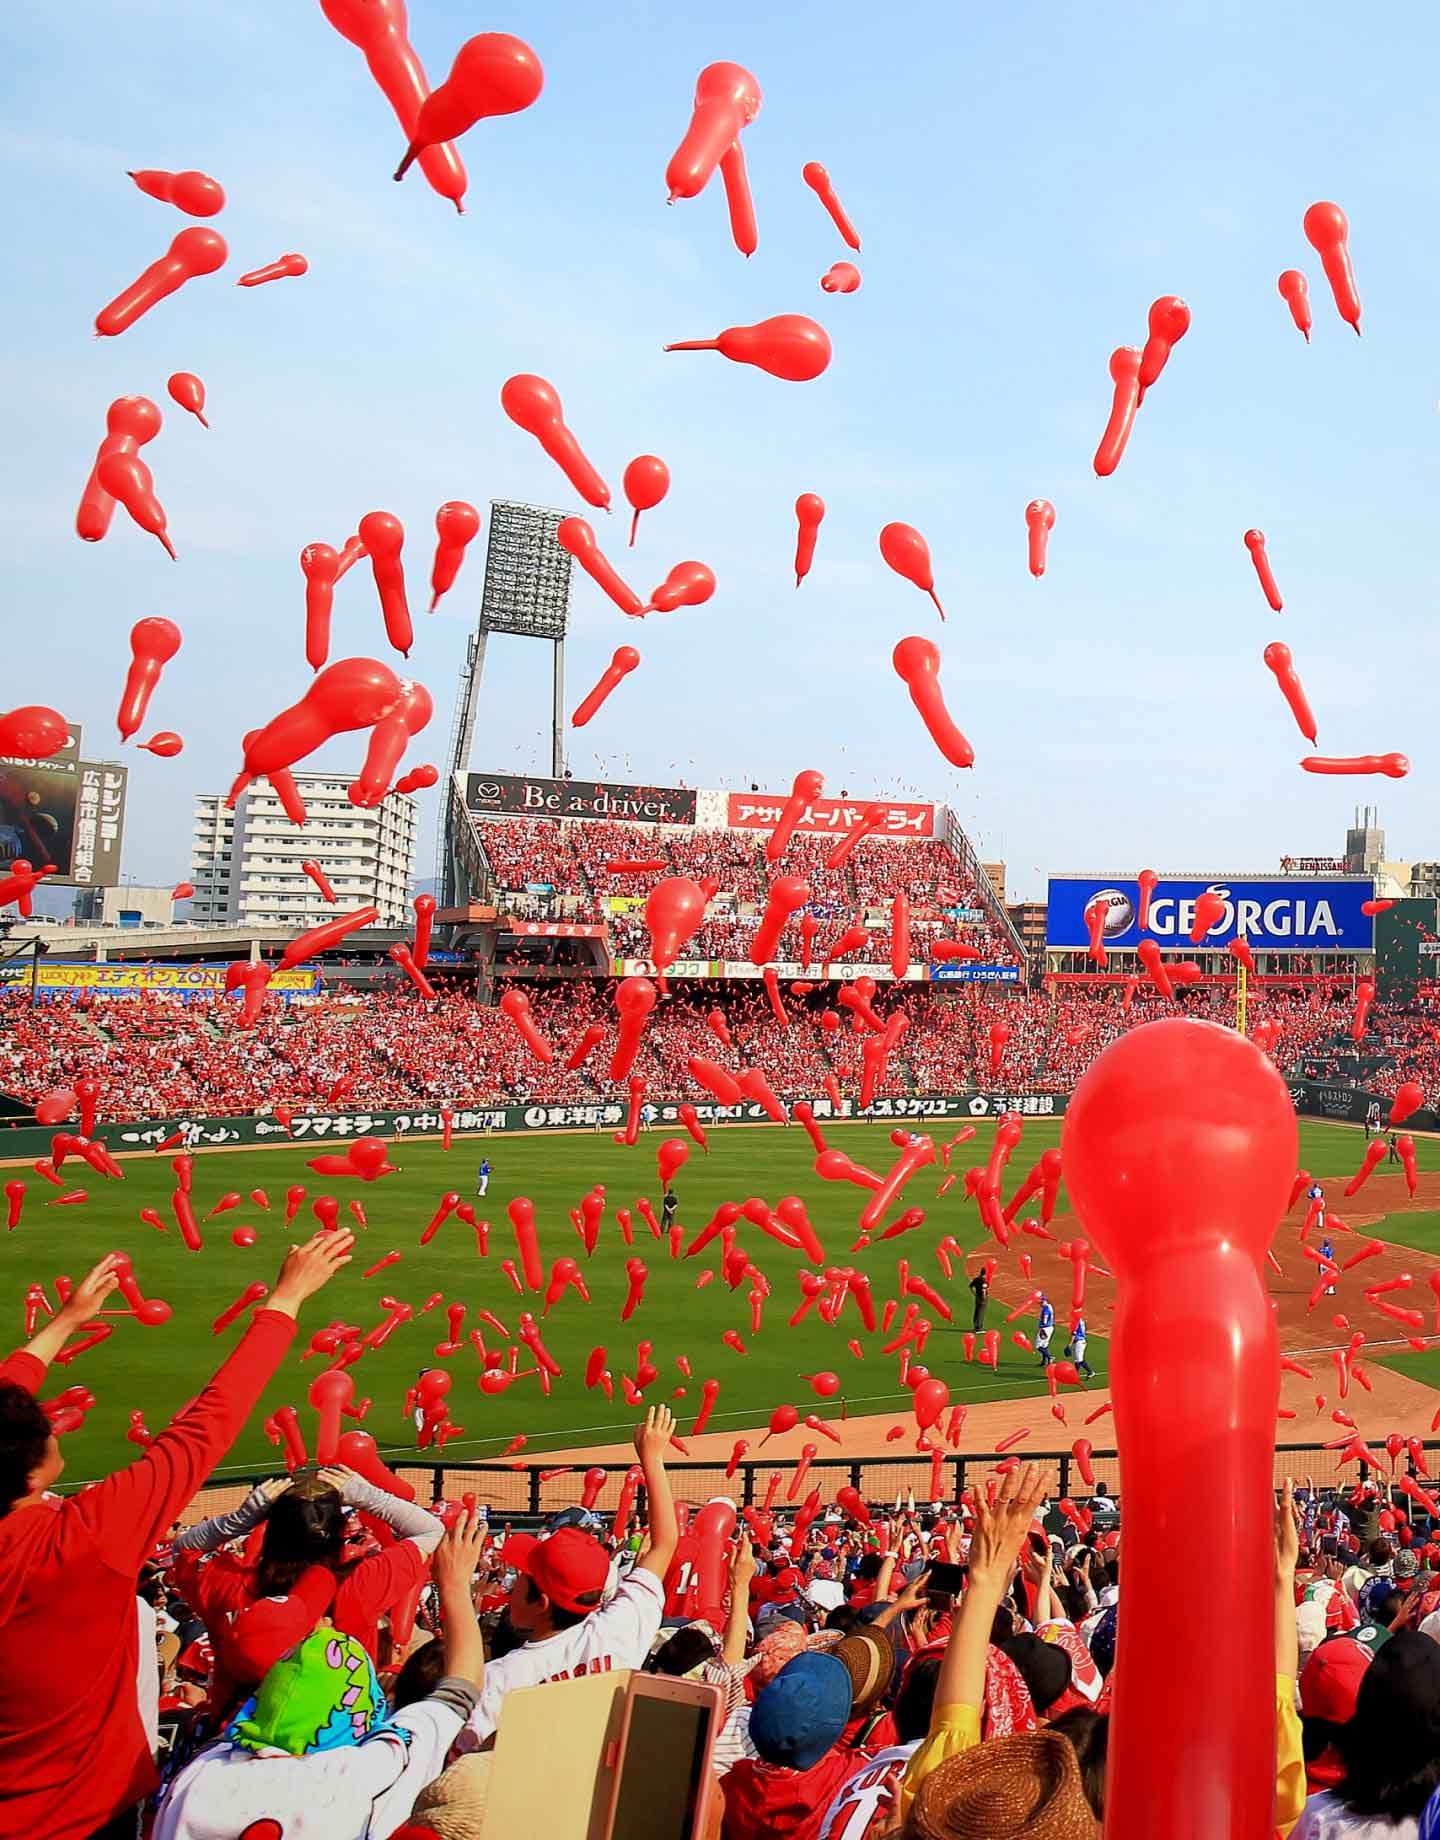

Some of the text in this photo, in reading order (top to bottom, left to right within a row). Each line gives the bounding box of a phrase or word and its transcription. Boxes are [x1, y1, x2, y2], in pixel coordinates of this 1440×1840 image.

[525, 785, 677, 818] Be a driver.
[74, 770, 102, 882] 広島市信用組合
[737, 805, 927, 830] アサスーパーライ
[97, 970, 228, 984] エディオン ZONE
[662, 1104, 742, 1121] SZUKI
[290, 1115, 386, 1137] フマキラー
